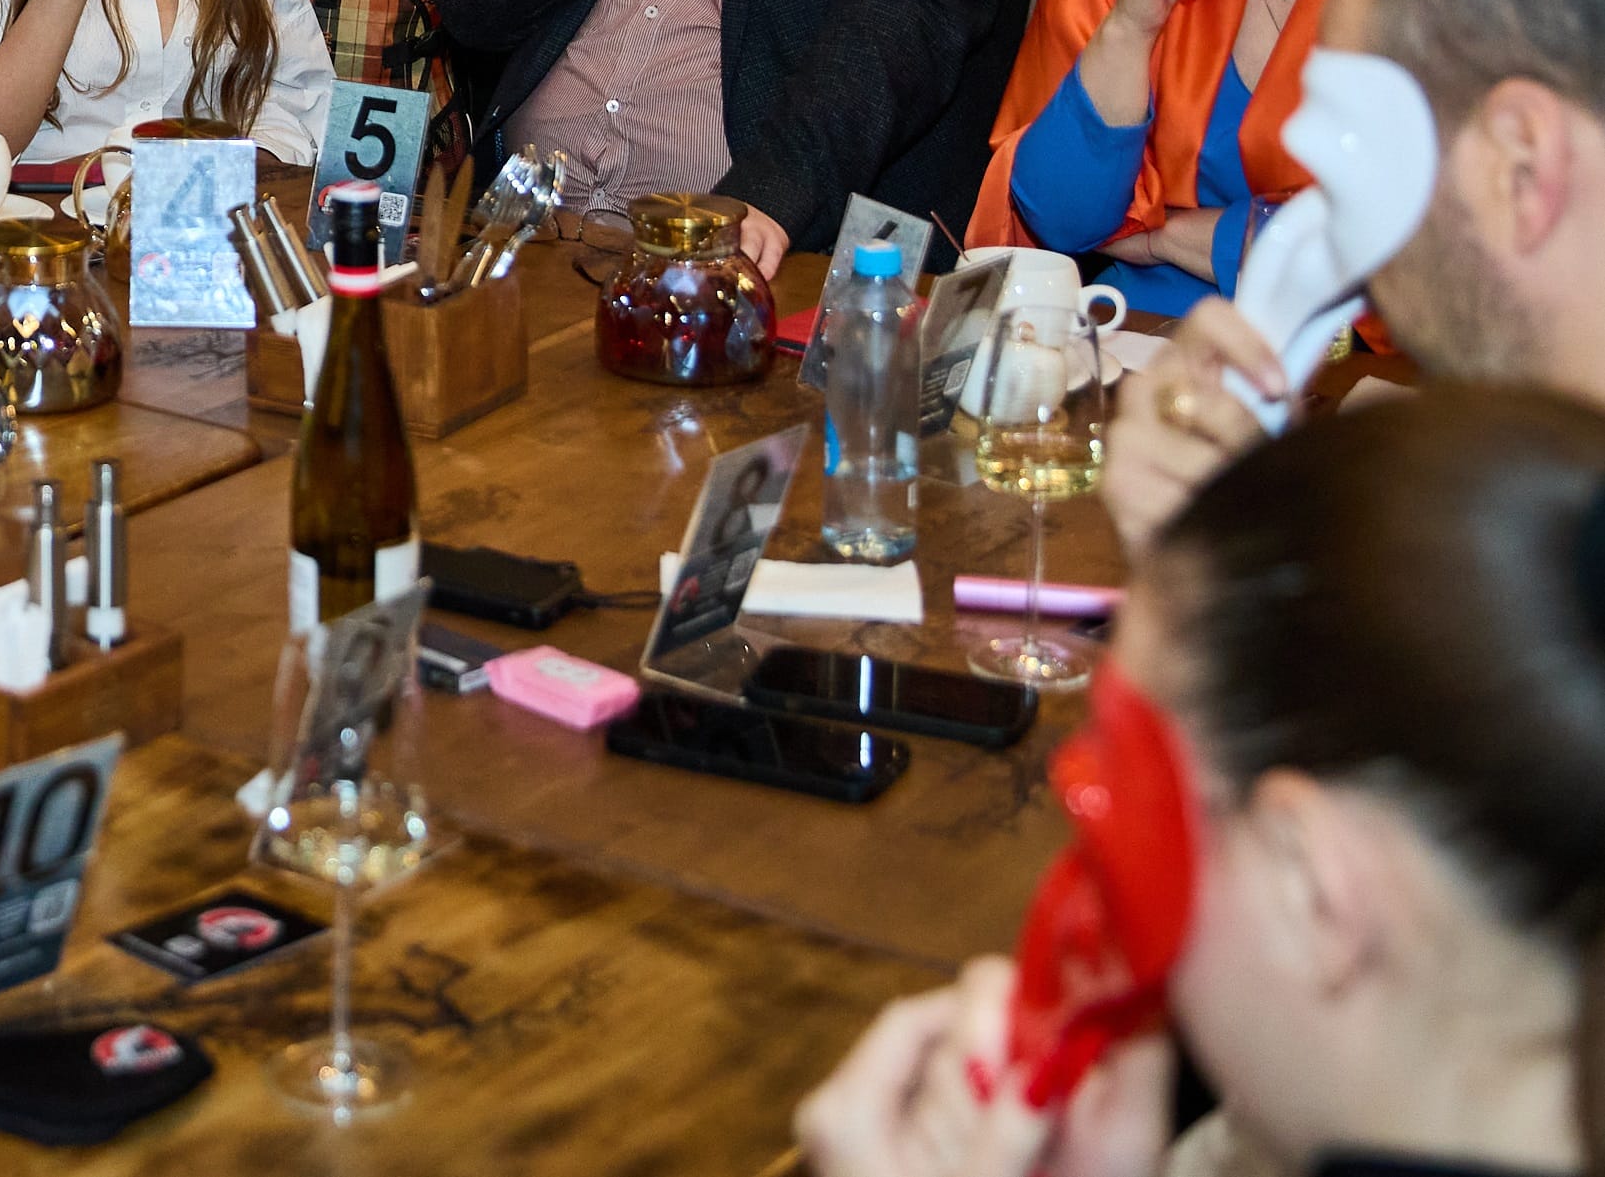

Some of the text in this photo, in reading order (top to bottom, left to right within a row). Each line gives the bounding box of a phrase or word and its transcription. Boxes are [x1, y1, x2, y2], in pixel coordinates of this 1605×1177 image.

[345, 96, 397, 180] 5
[161, 155, 222, 228] 4
[711, 454, 772, 555] 8
